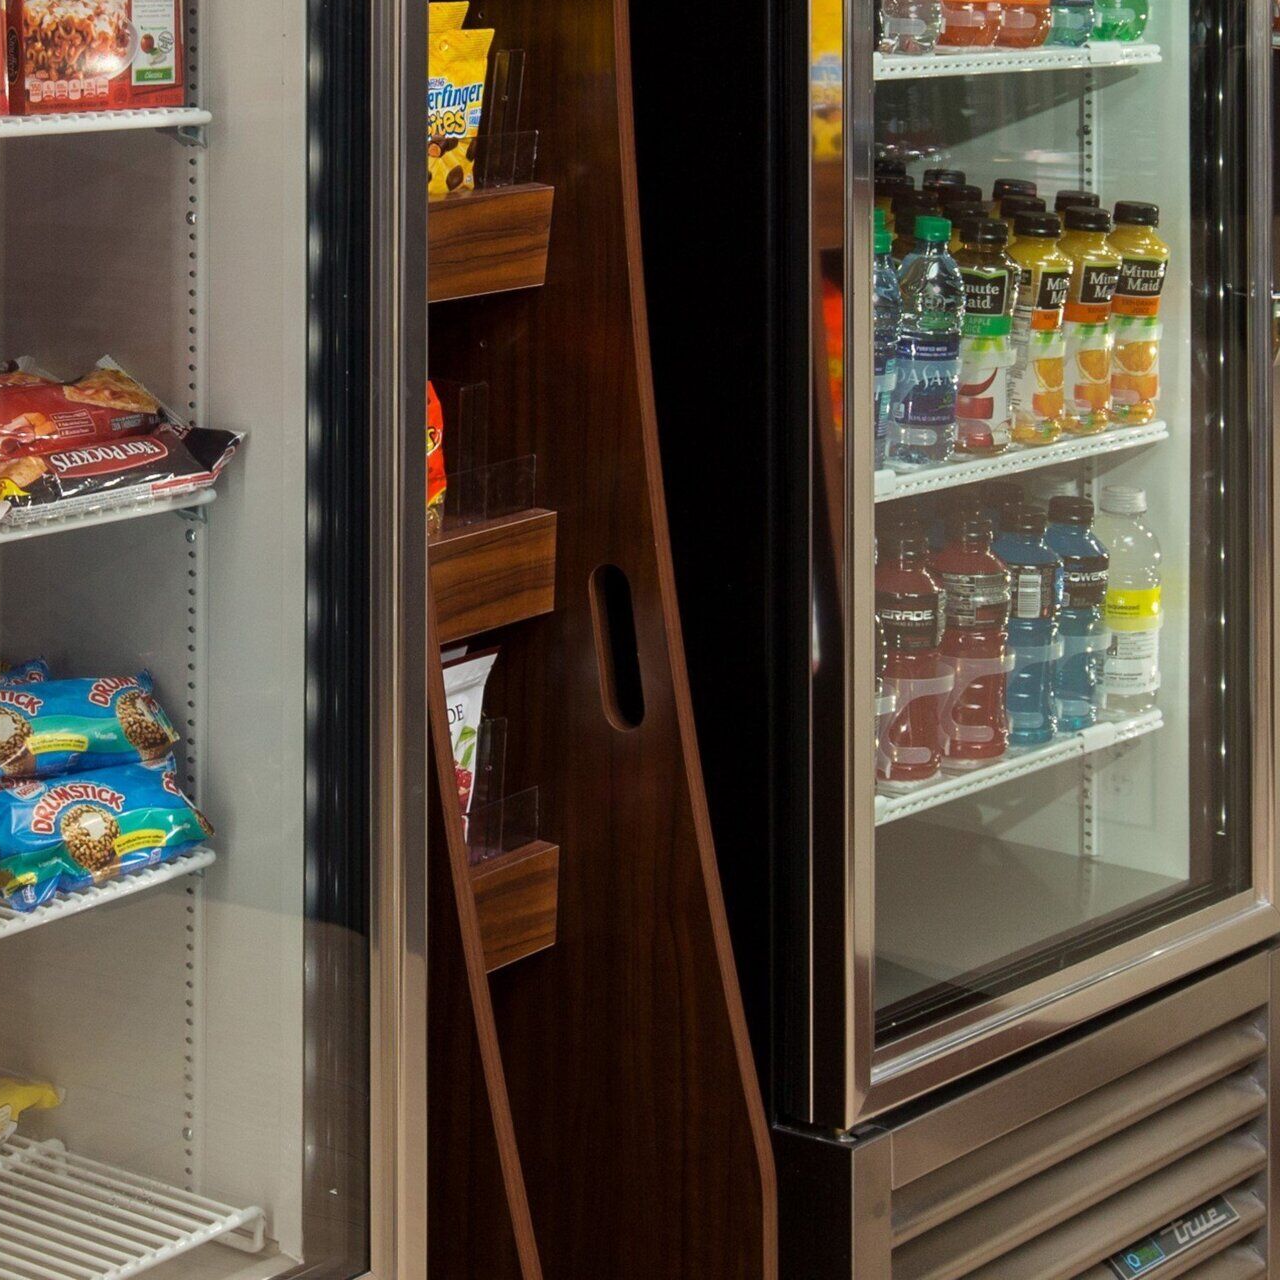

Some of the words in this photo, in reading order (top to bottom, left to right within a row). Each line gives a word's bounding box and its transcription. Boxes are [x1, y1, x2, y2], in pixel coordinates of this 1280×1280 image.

[1128, 278, 1161, 292] Maid
[50, 445, 127, 473] POCKETS
[121, 441, 161, 456] HOT
[31, 783, 124, 833] DRUMSTICK
